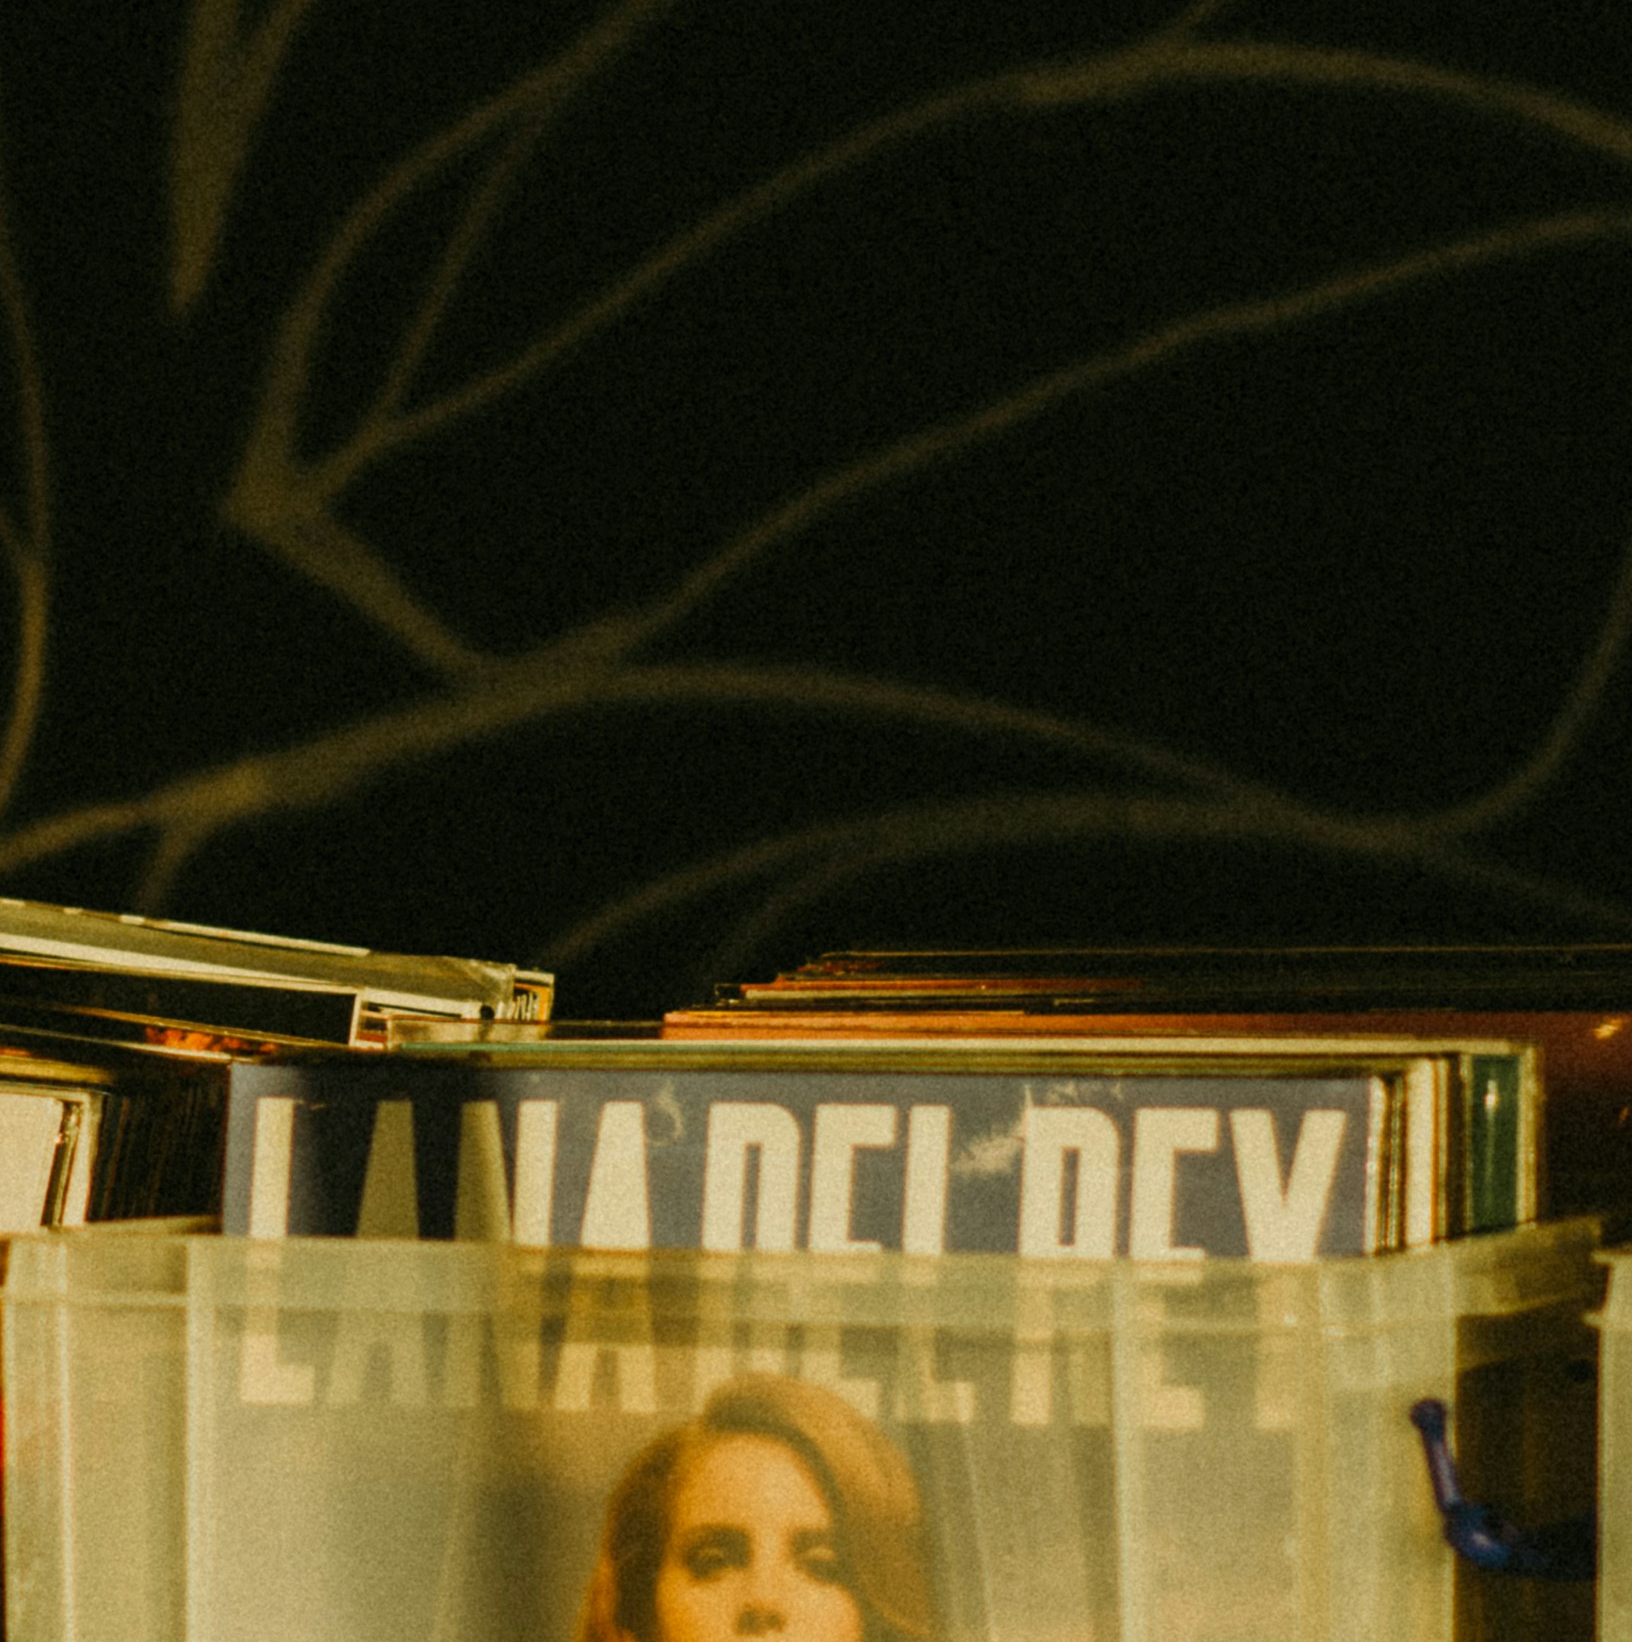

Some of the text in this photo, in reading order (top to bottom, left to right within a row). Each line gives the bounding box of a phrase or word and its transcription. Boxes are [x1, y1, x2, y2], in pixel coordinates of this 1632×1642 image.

[239, 1095, 1348, 1433] LANA DEL REY
